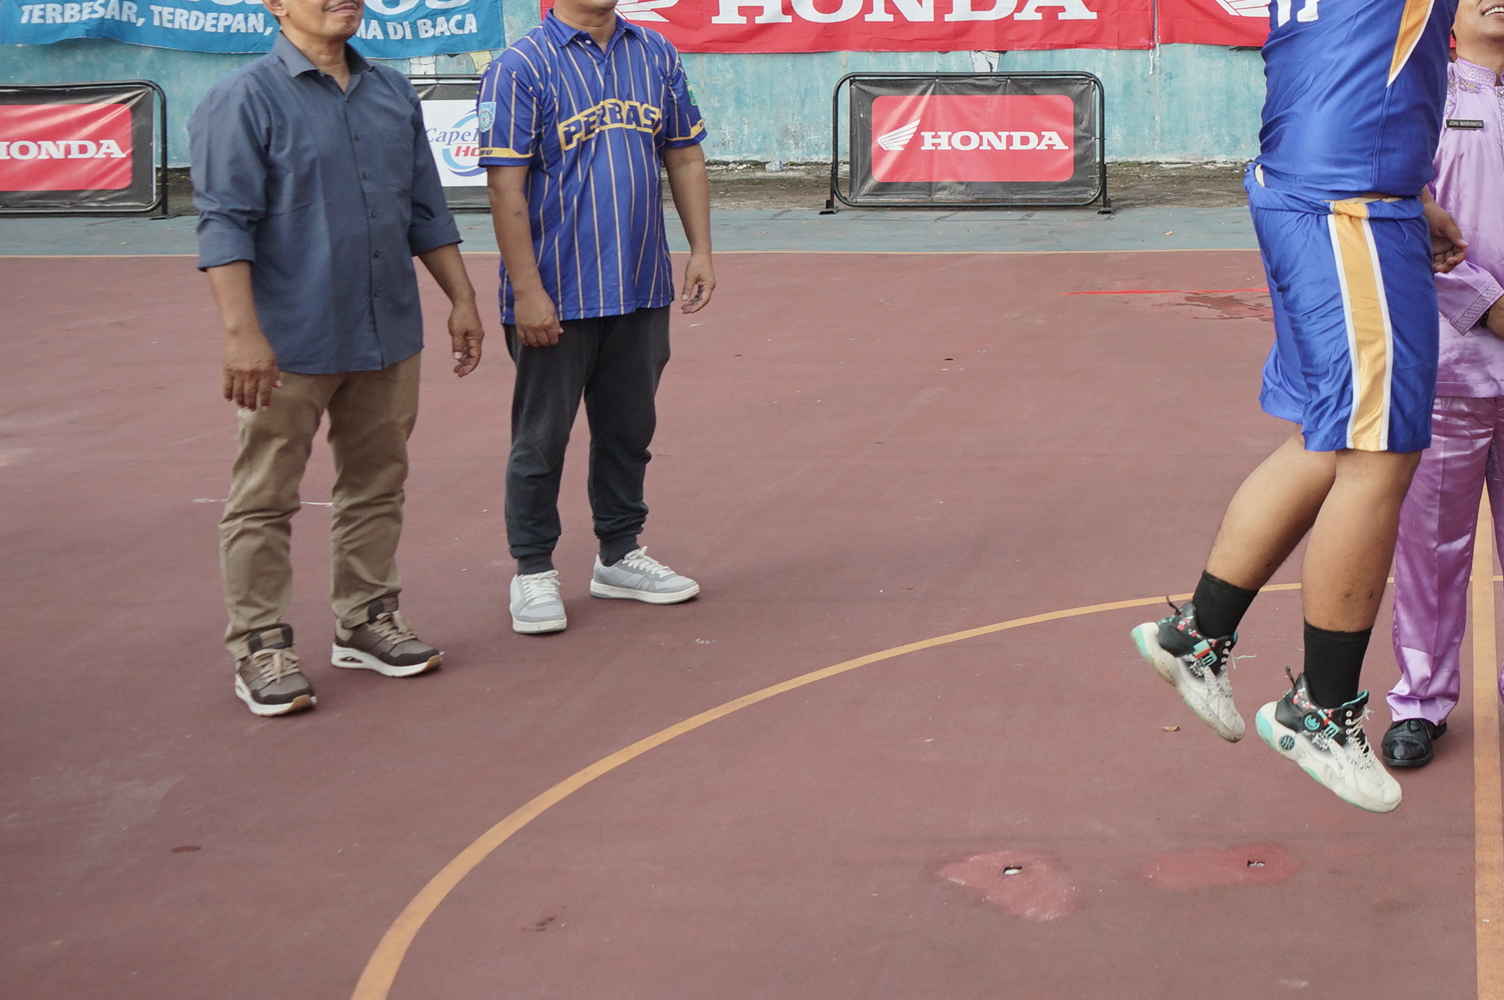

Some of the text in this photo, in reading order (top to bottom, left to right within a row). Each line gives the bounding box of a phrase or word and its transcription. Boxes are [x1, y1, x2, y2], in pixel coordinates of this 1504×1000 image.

[150, 4, 273, 35] TERDEPAN,
[386, 20, 413, 40] DI
[417, 13, 478, 39] BACA
[920, 130, 1069, 151] HONDA
